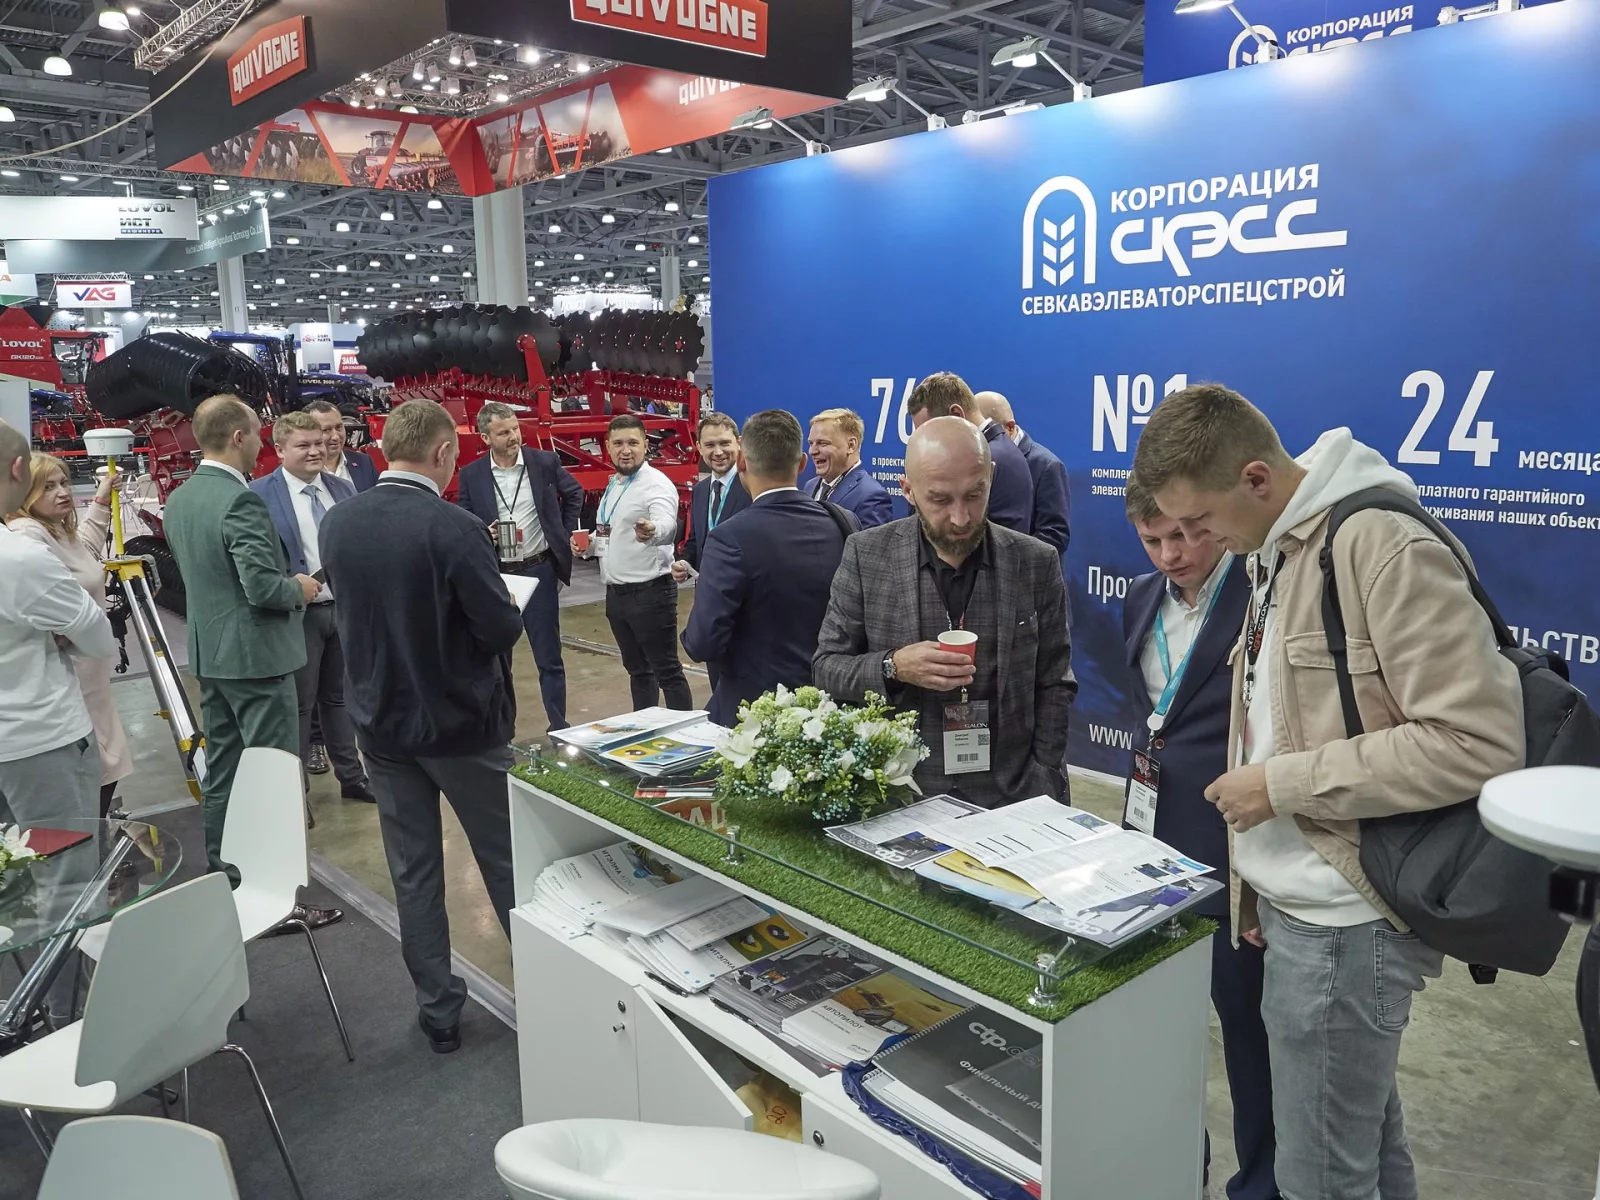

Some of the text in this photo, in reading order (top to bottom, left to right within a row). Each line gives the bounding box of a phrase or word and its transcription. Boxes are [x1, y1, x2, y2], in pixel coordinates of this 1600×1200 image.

[585, 0, 757, 41] VOGNE
[1286, 4, 1414, 45] КОРПОРАЦИЯ
[232, 30, 300, 94] QUIVOGNE
[1110, 163, 1320, 213] КОРПОРАЦИЯ
[118, 203, 175, 213] LOVOL
[1021, 268, 1346, 315] СЕВКАВЭЛЕВАТОРСПЕЦСТРОЙ
[2, 340, 44, 348] LOVOL
[1397, 369, 1500, 467] 24
[871, 456, 907, 468] в проекти
[872, 471, 877, 480] и
[1416, 484, 1586, 507] платного гарантийного
[1498, 511, 1546, 527] наших
[1087, 565, 1134, 604] Про
[822, 1004, 864, 1029] АВТОПИЛОТ
[959, 1060, 1029, 1102] Финальный
